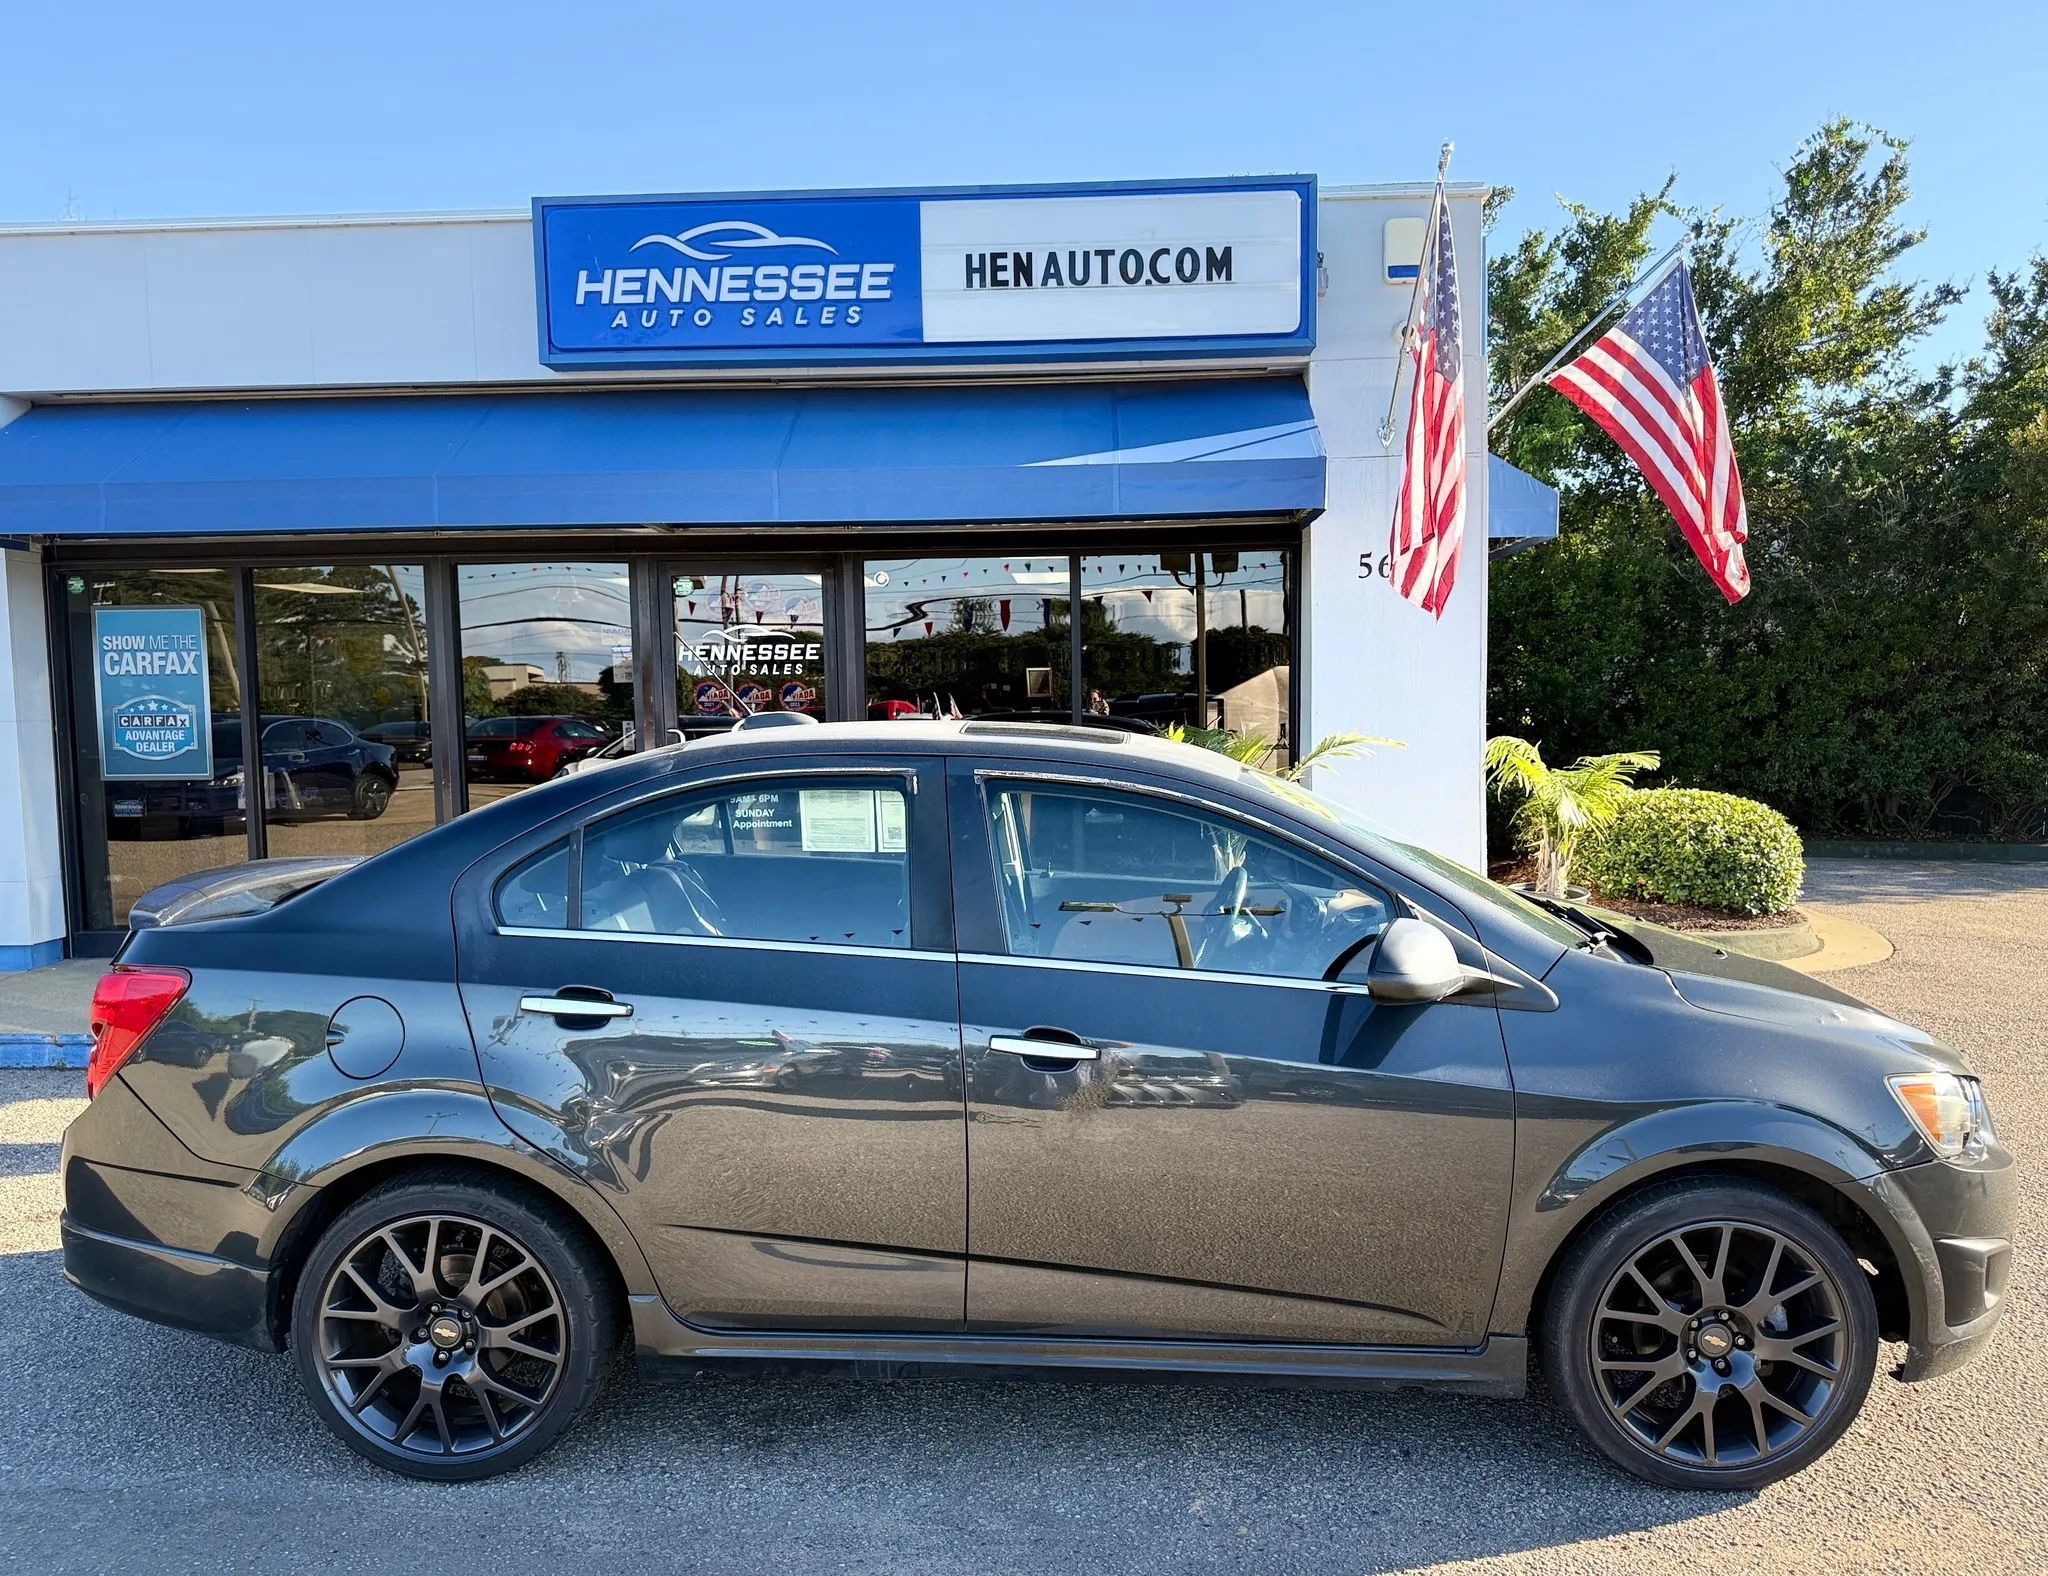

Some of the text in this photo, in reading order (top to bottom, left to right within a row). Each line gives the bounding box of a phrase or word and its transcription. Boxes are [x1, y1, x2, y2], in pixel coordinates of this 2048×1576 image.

[965, 246, 1233, 289] HENAUTO.COM
[575, 263, 896, 306] HENNESSEE
[611, 306, 863, 328] AUTO SALES
[103, 634, 197, 650] SHOW ME THE
[678, 643, 821, 662] HENNESSEE
[104, 651, 199, 677] CARFAX
[693, 663, 804, 676] AUTO SALES
[120, 715, 188, 728] CARFAX
[125, 730, 185, 741] ADVANTAGE
[136, 742, 176, 753] DEALER
[735, 808, 775, 818] SUNDAY
[733, 819, 793, 830] Appointment
